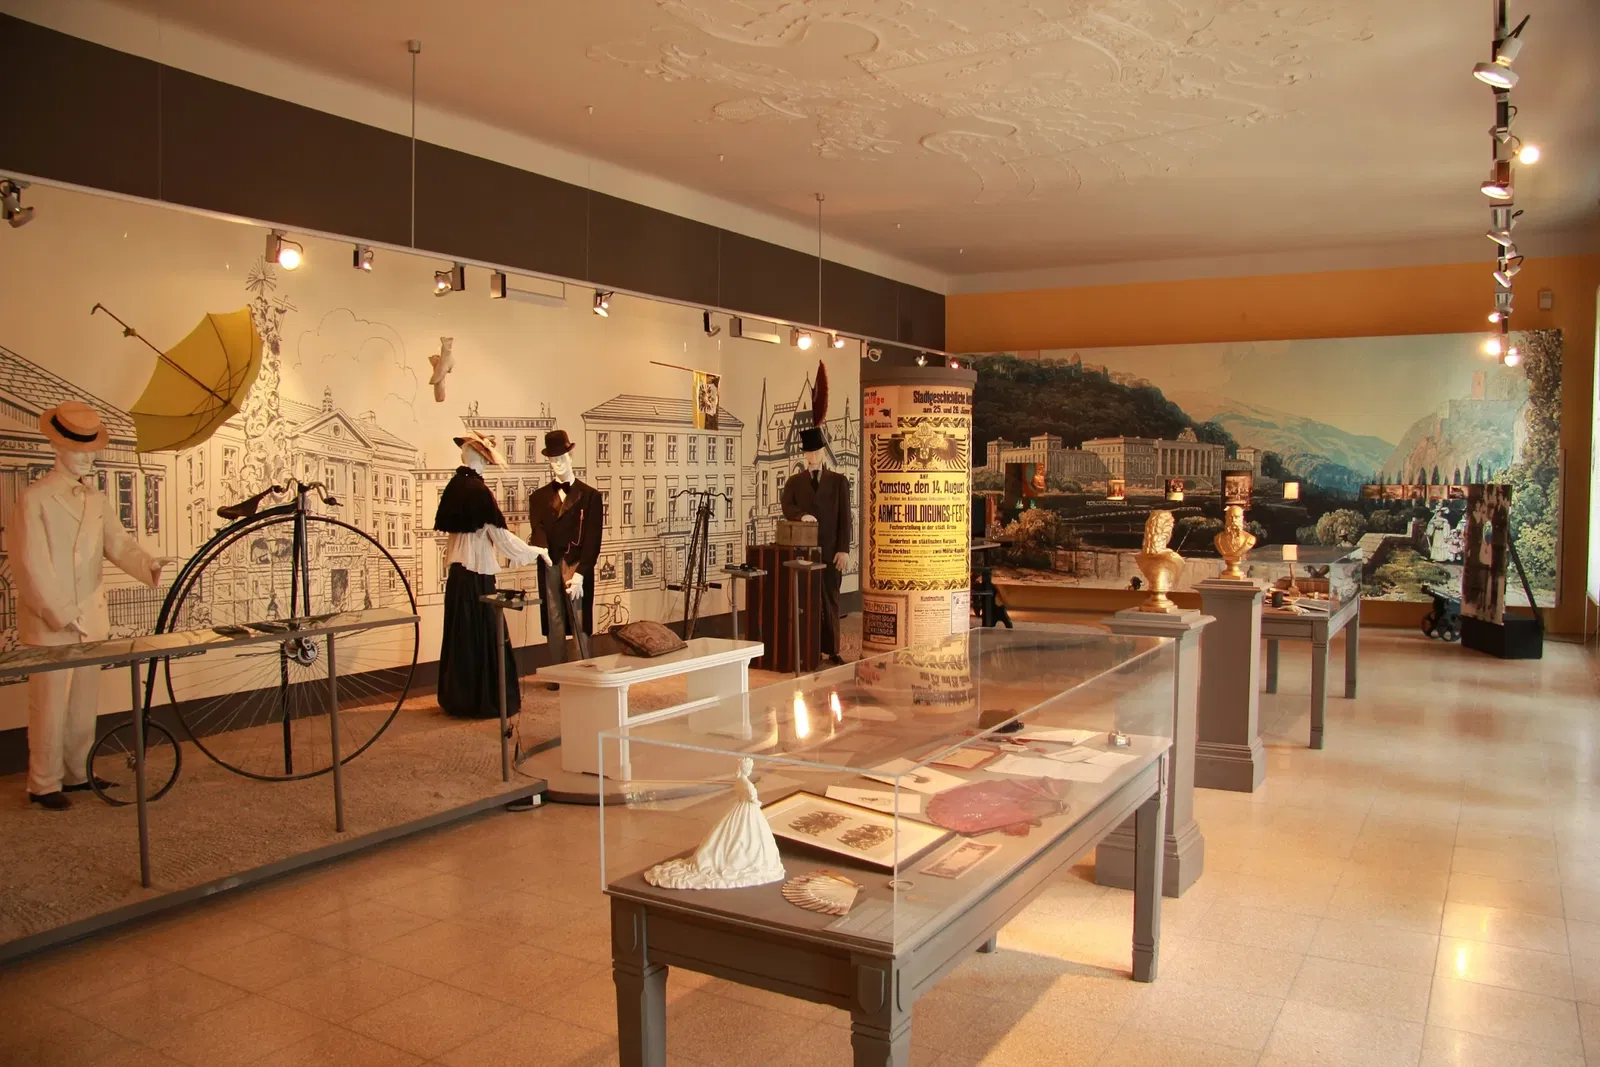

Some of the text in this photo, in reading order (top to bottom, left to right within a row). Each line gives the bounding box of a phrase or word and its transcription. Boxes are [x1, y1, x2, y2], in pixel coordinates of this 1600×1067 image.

[878, 480, 965, 495] Samstag, den 14. August
[878, 504, 965, 523] ARMEE-HULDIGUNGS-FEST
